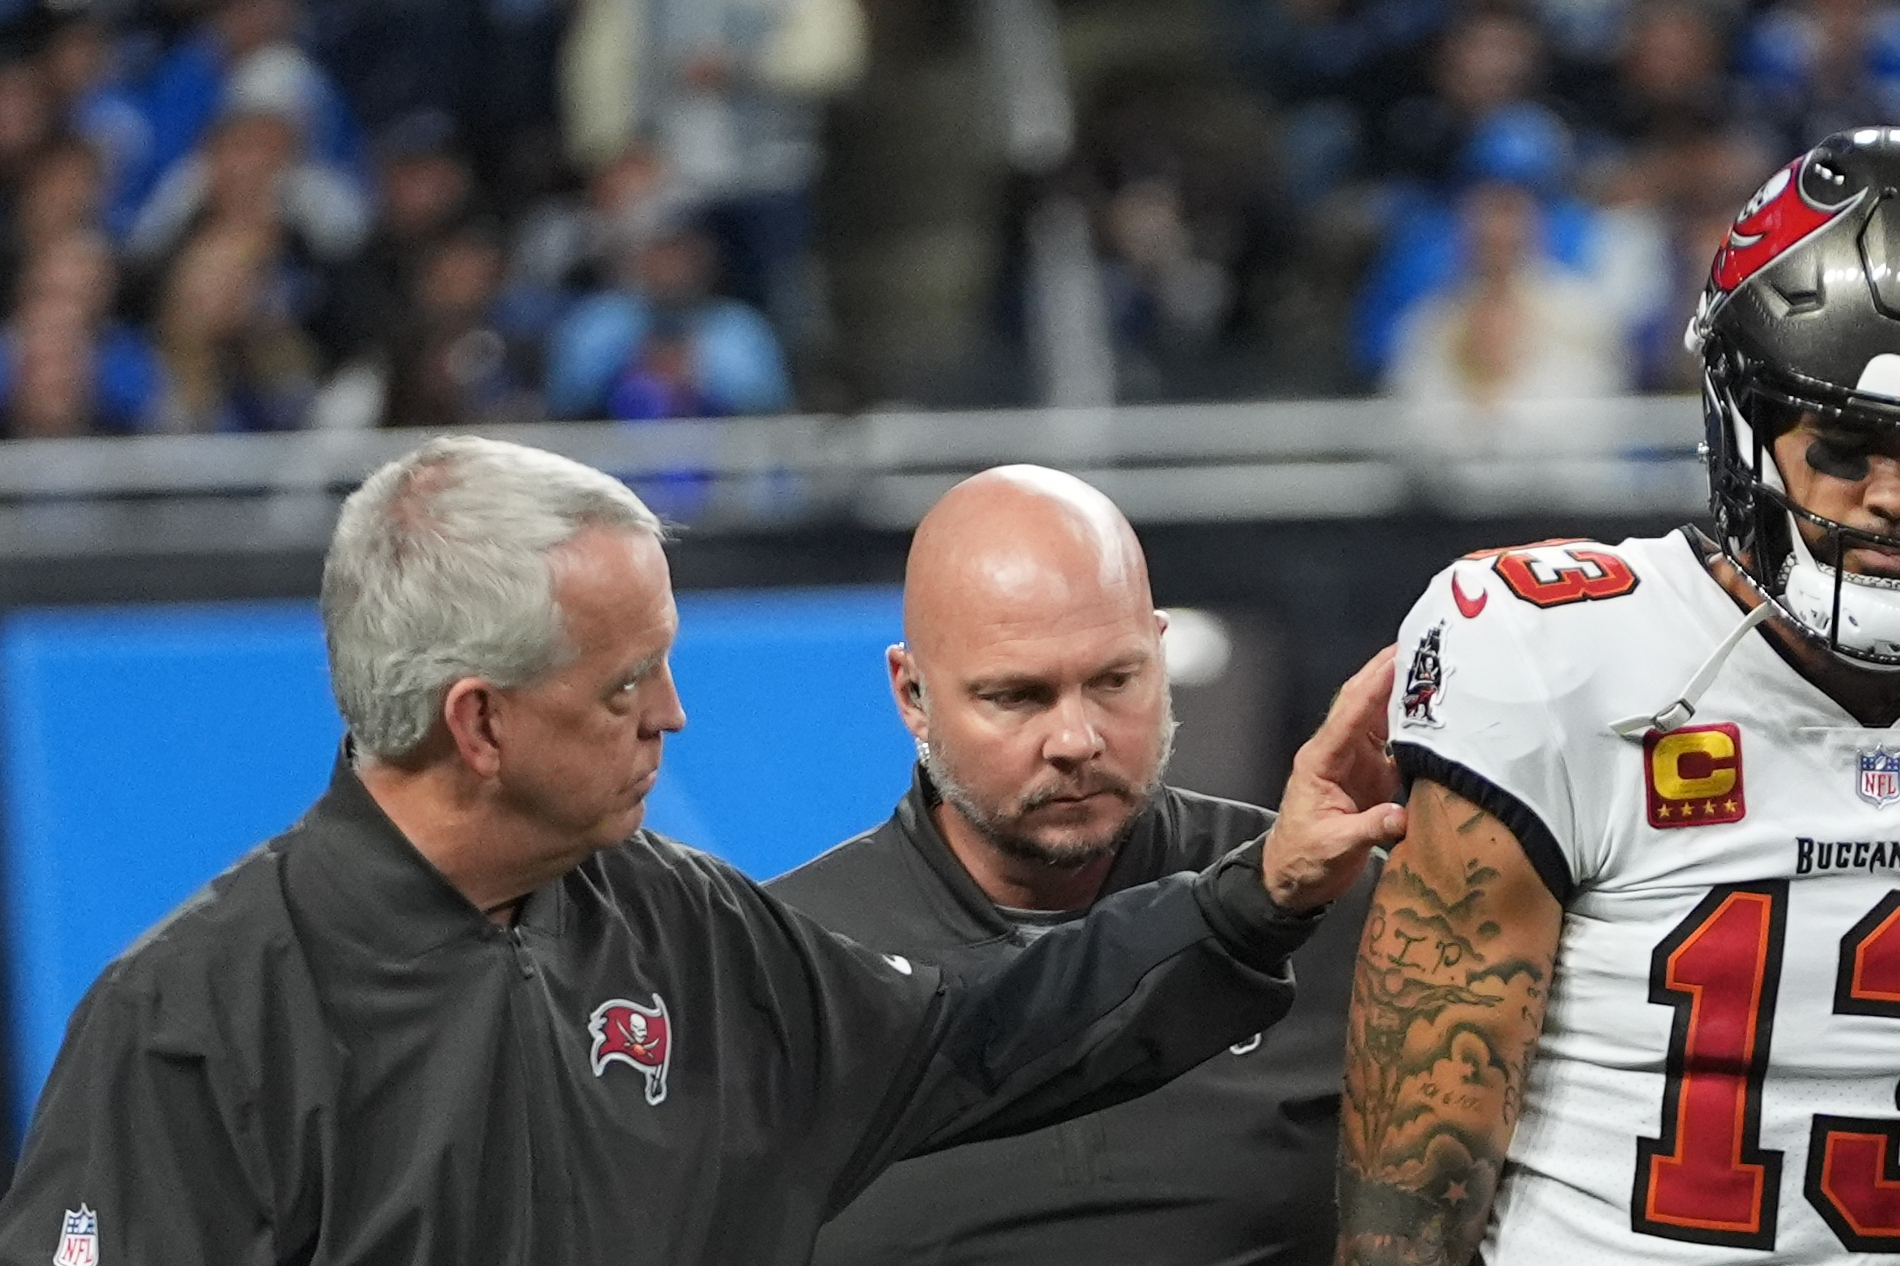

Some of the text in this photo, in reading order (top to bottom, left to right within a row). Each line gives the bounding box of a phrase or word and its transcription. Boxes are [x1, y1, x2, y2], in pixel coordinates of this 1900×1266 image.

[1450, 537, 1641, 609] 3
[1865, 773, 1896, 797] NFL
[62, 1238, 93, 1266] NFL
